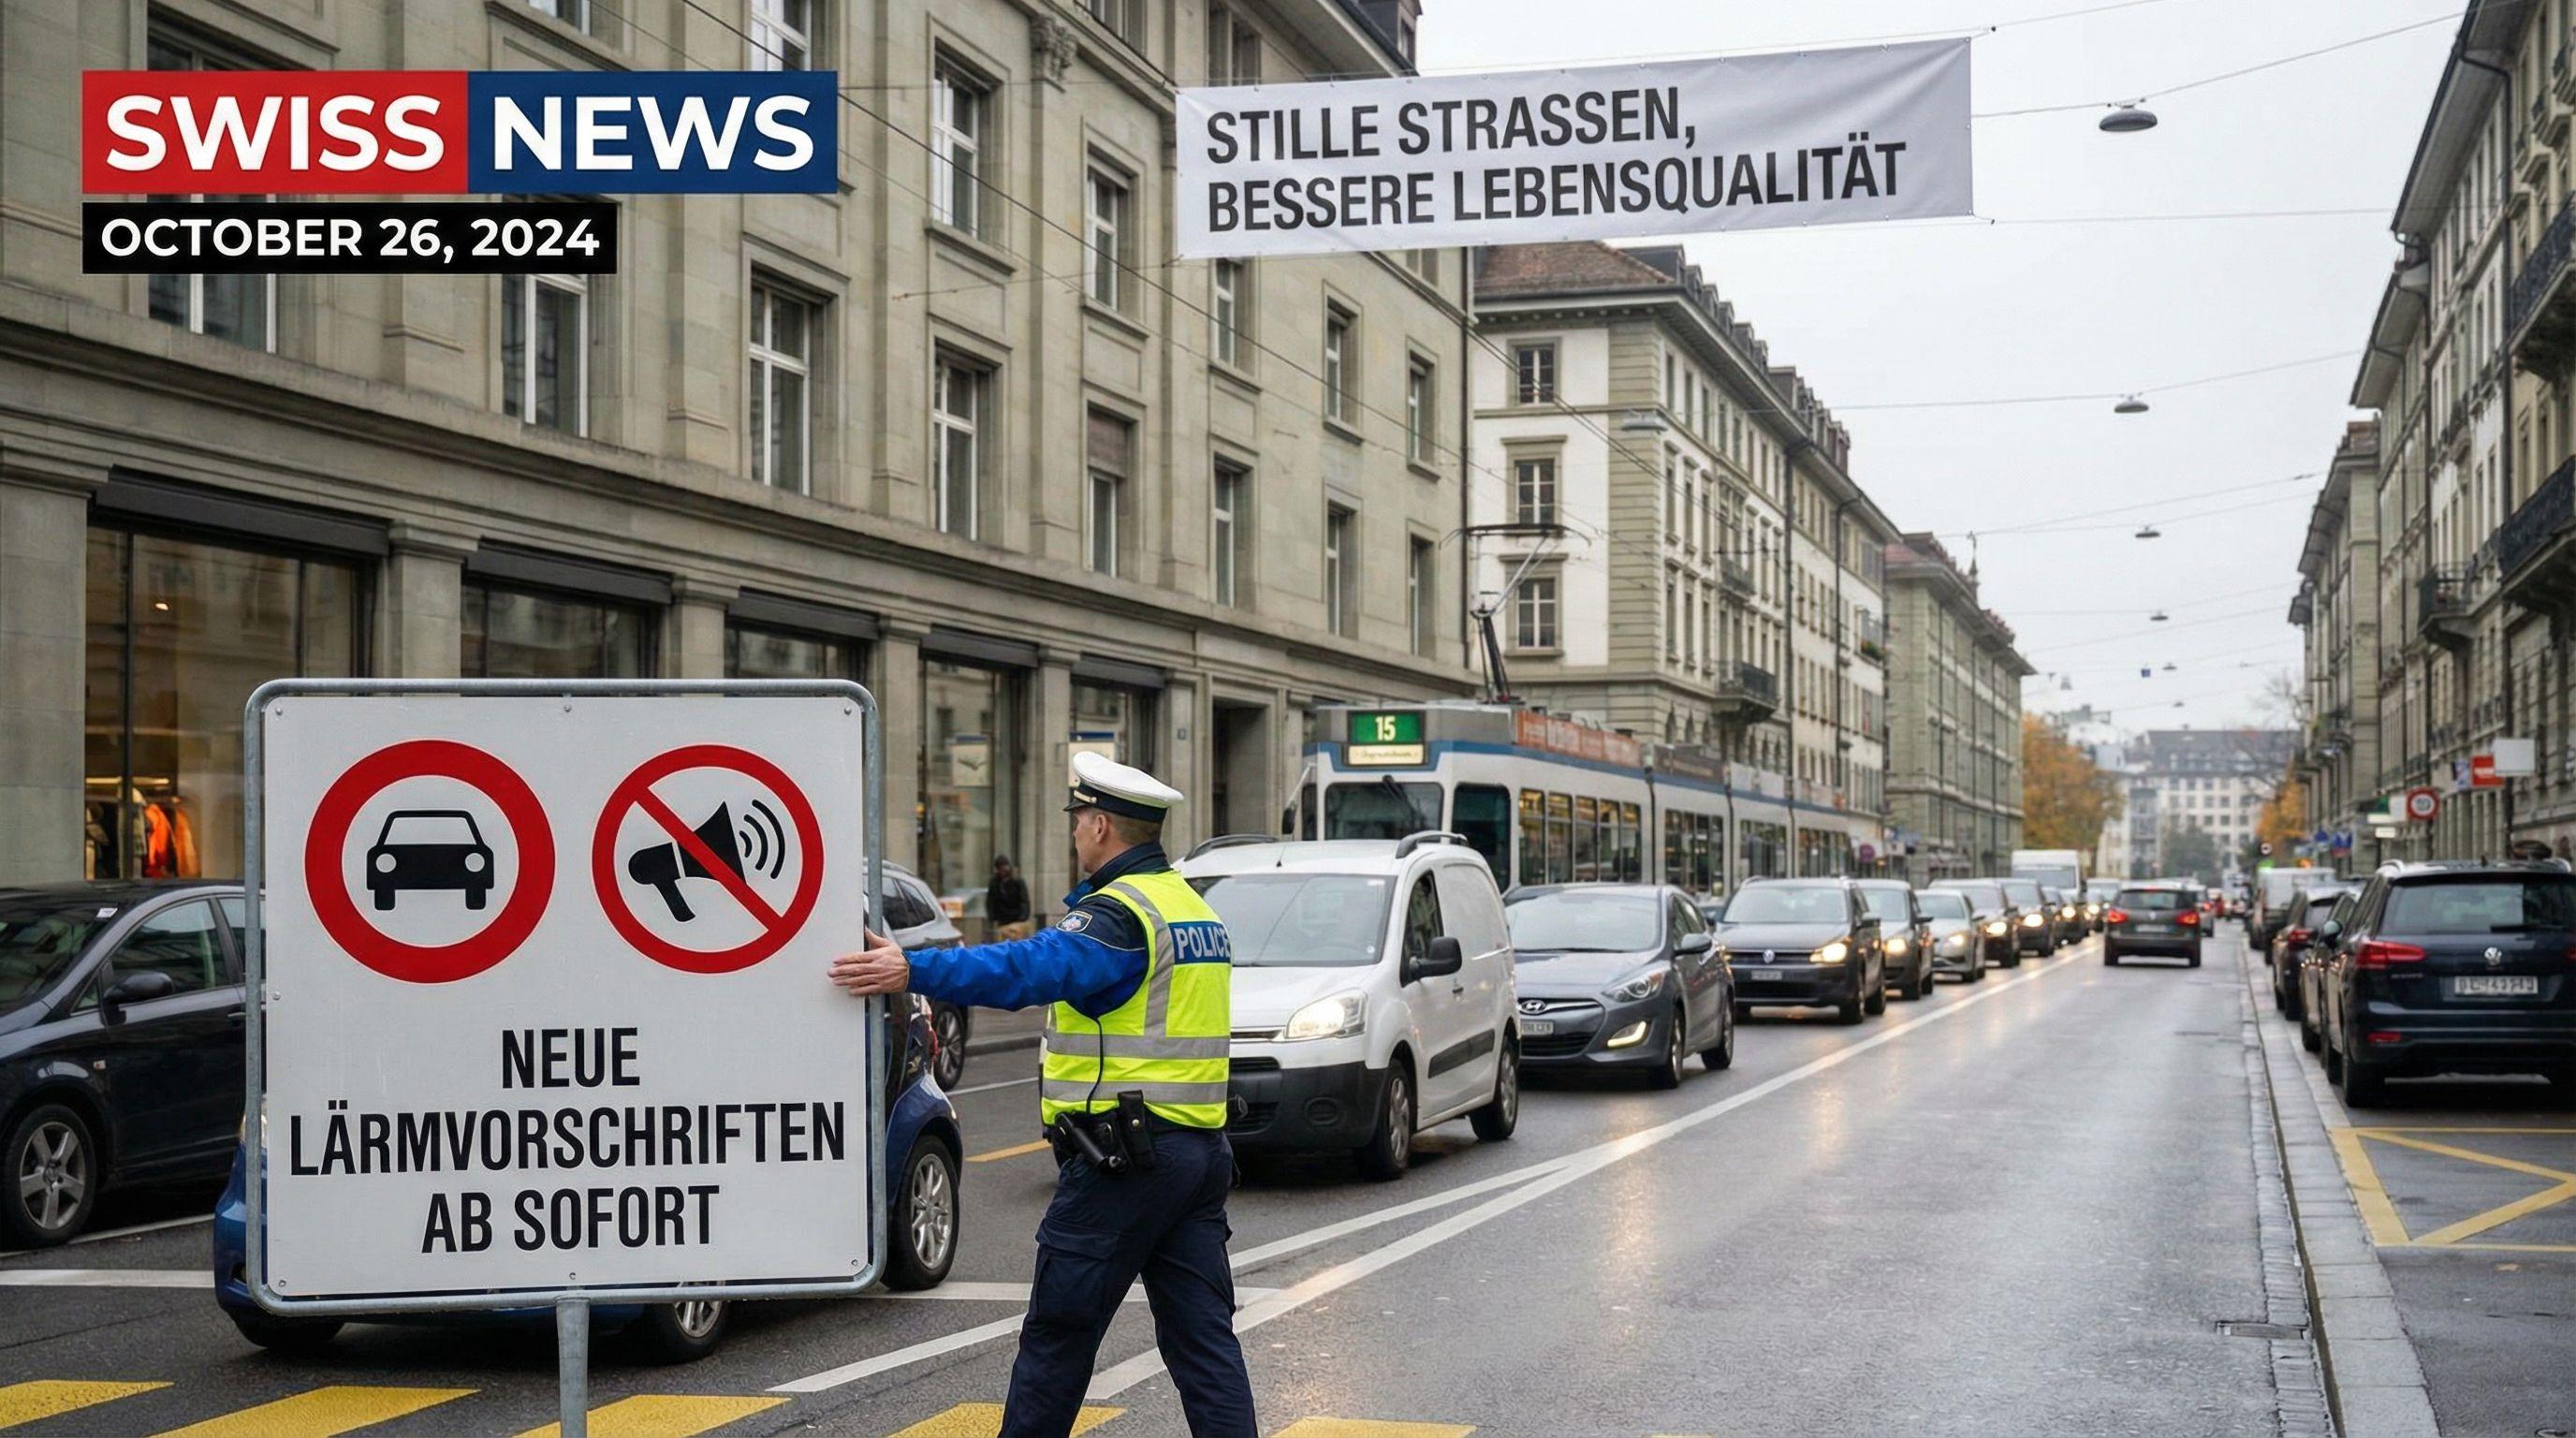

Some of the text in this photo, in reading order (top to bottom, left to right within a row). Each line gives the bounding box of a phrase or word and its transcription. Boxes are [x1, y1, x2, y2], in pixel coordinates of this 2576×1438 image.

[1207, 86, 1695, 165] STILLE STRASSEN,
[1208, 131, 1907, 232] BESSERE LEBENSQUALITÄT
[1375, 715, 1397, 741] 15
[502, 1027, 640, 1089] NEUE
[290, 1099, 844, 1176] LÄRMVORSCHRIFTEN
[421, 1184, 720, 1254] AB SOFORT
